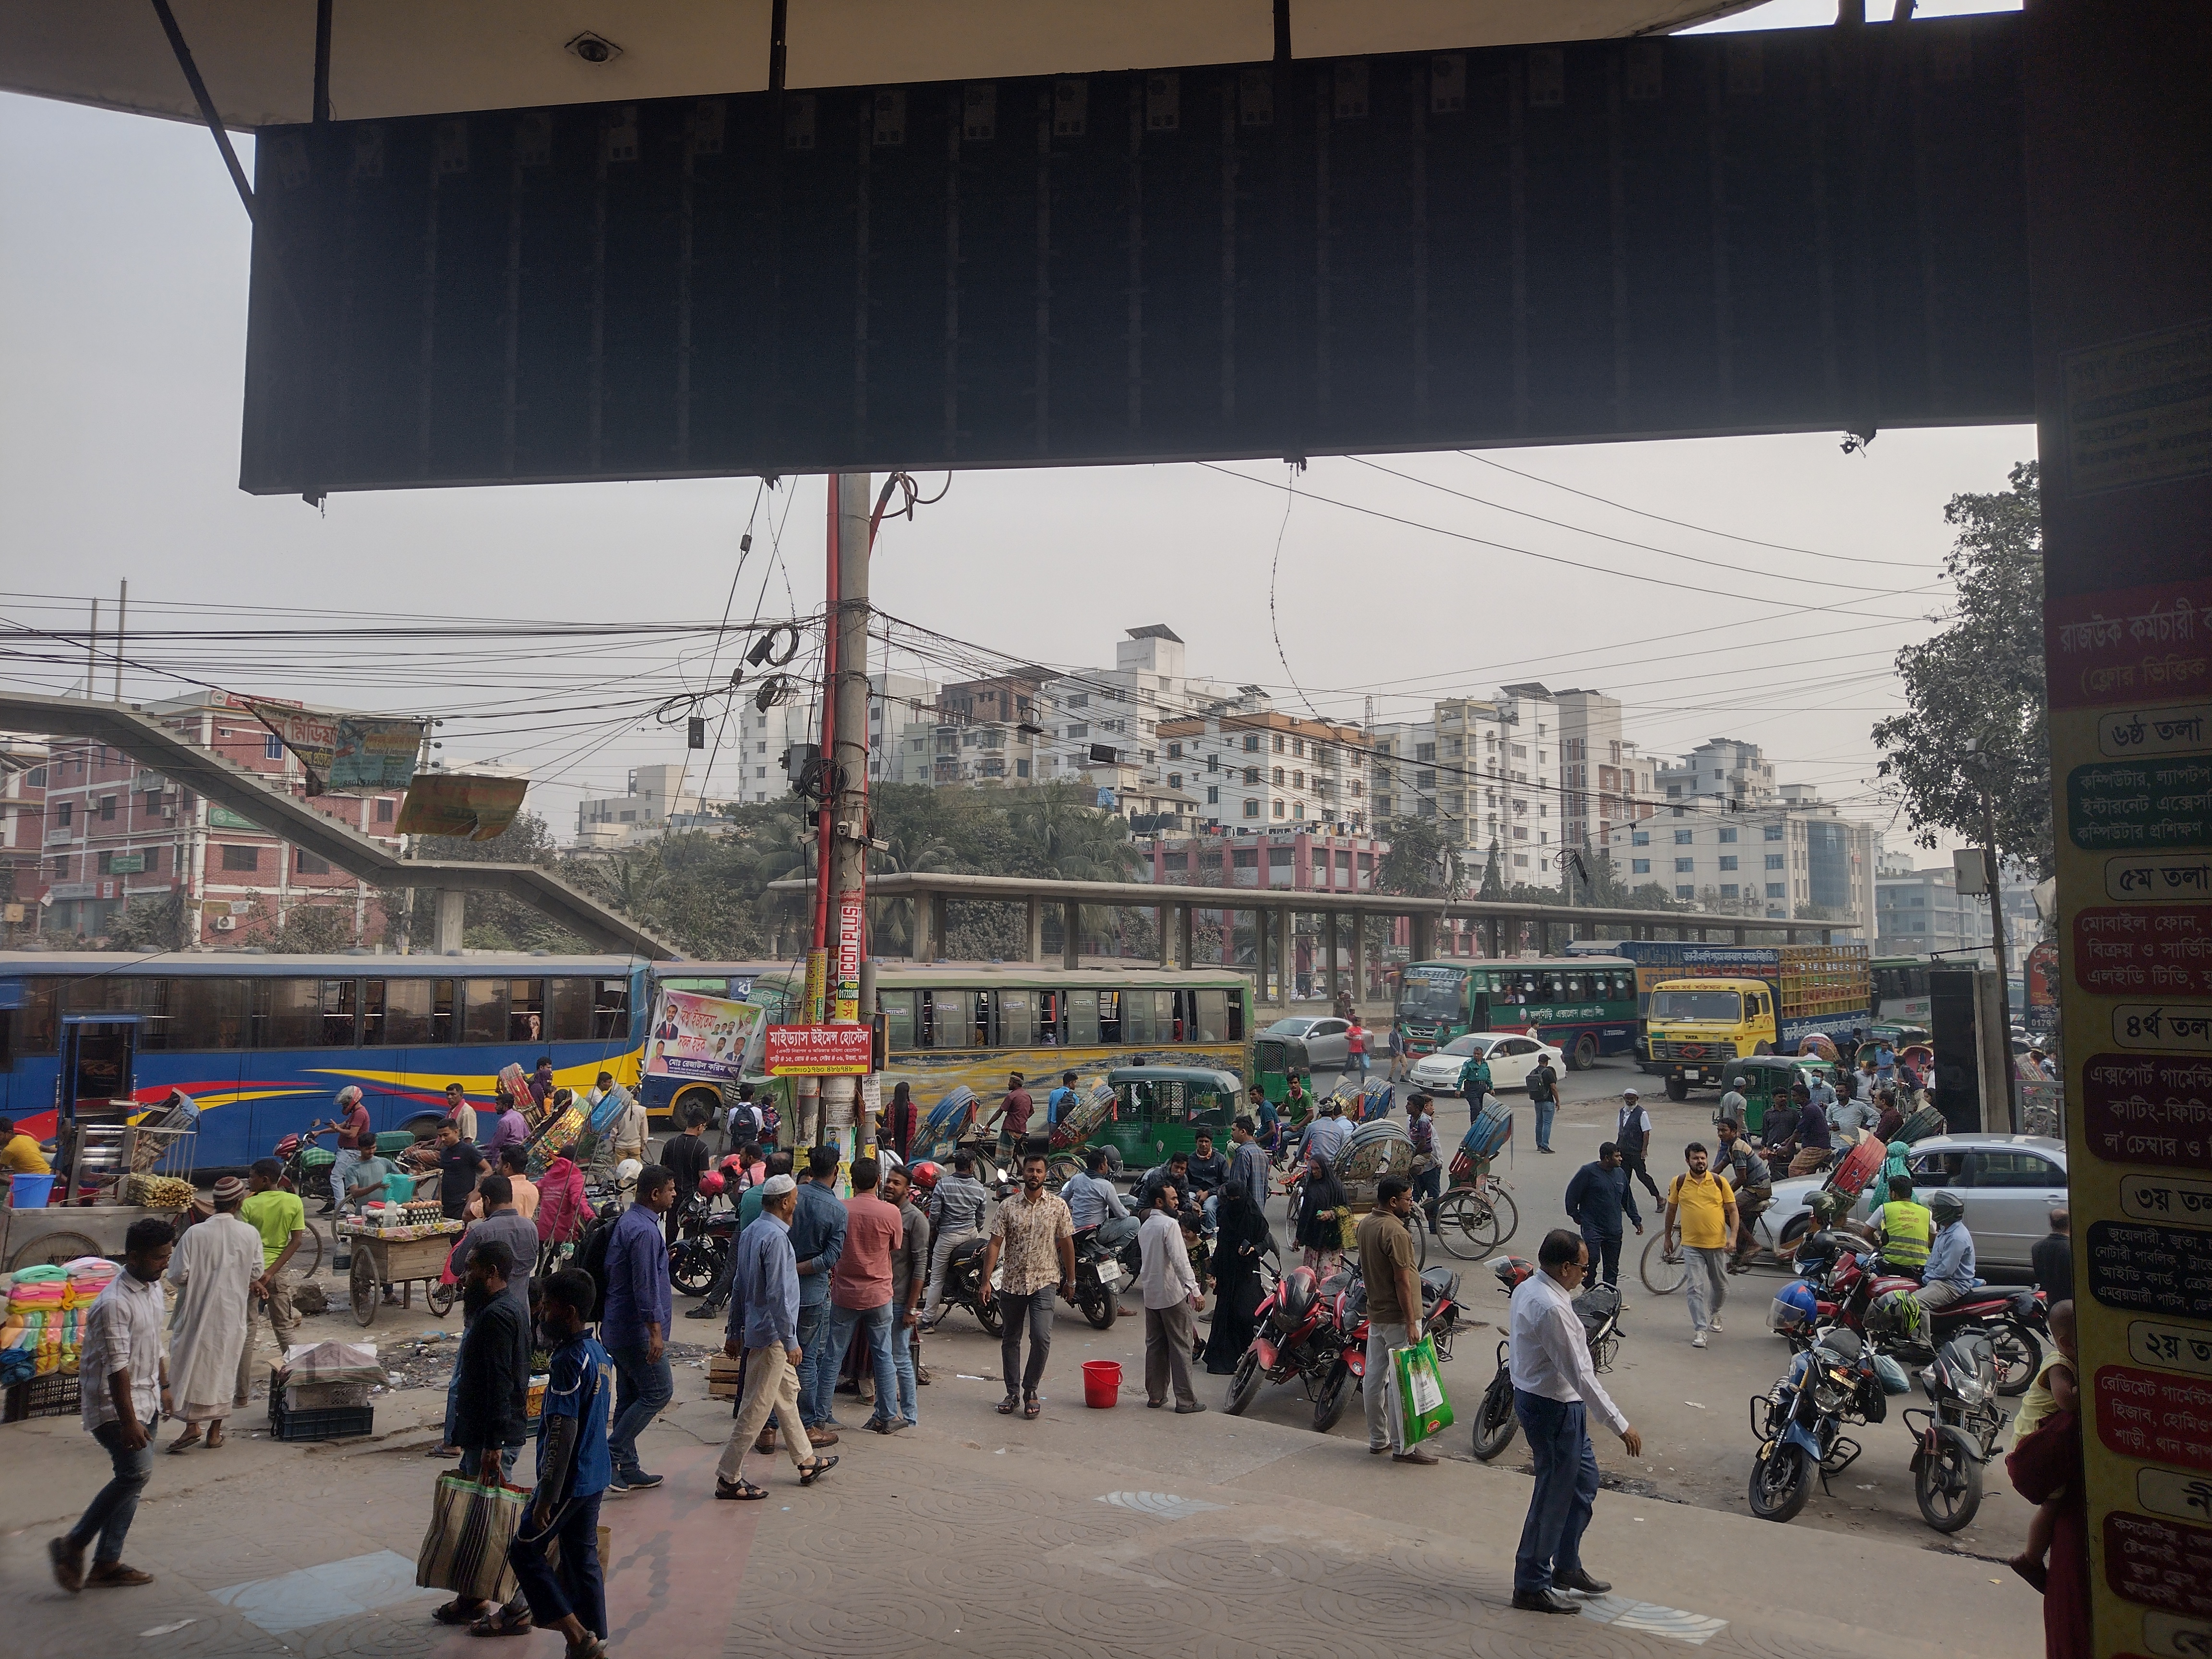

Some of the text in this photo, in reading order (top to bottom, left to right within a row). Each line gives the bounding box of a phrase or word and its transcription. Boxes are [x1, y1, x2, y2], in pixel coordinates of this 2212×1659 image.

[2152, 716, 2204, 742] তলা
[2120, 862, 2211, 891] ৫ম তলা
[842, 908, 858, 940] PLUS
[2081, 912, 2149, 933] মোবাইল
[840, 944, 856, 975] ICON
[2141, 943, 2154, 957] ও
[2087, 965, 2146, 986] এলইডি
[769, 1027, 809, 1047] মাইড্যাস
[840, 1027, 869, 1046] হোস্টেল
[2167, 1017, 2212, 1042] তল
[668, 1058, 681, 1067] মোঃ
[708, 1062, 726, 1072] করিম
